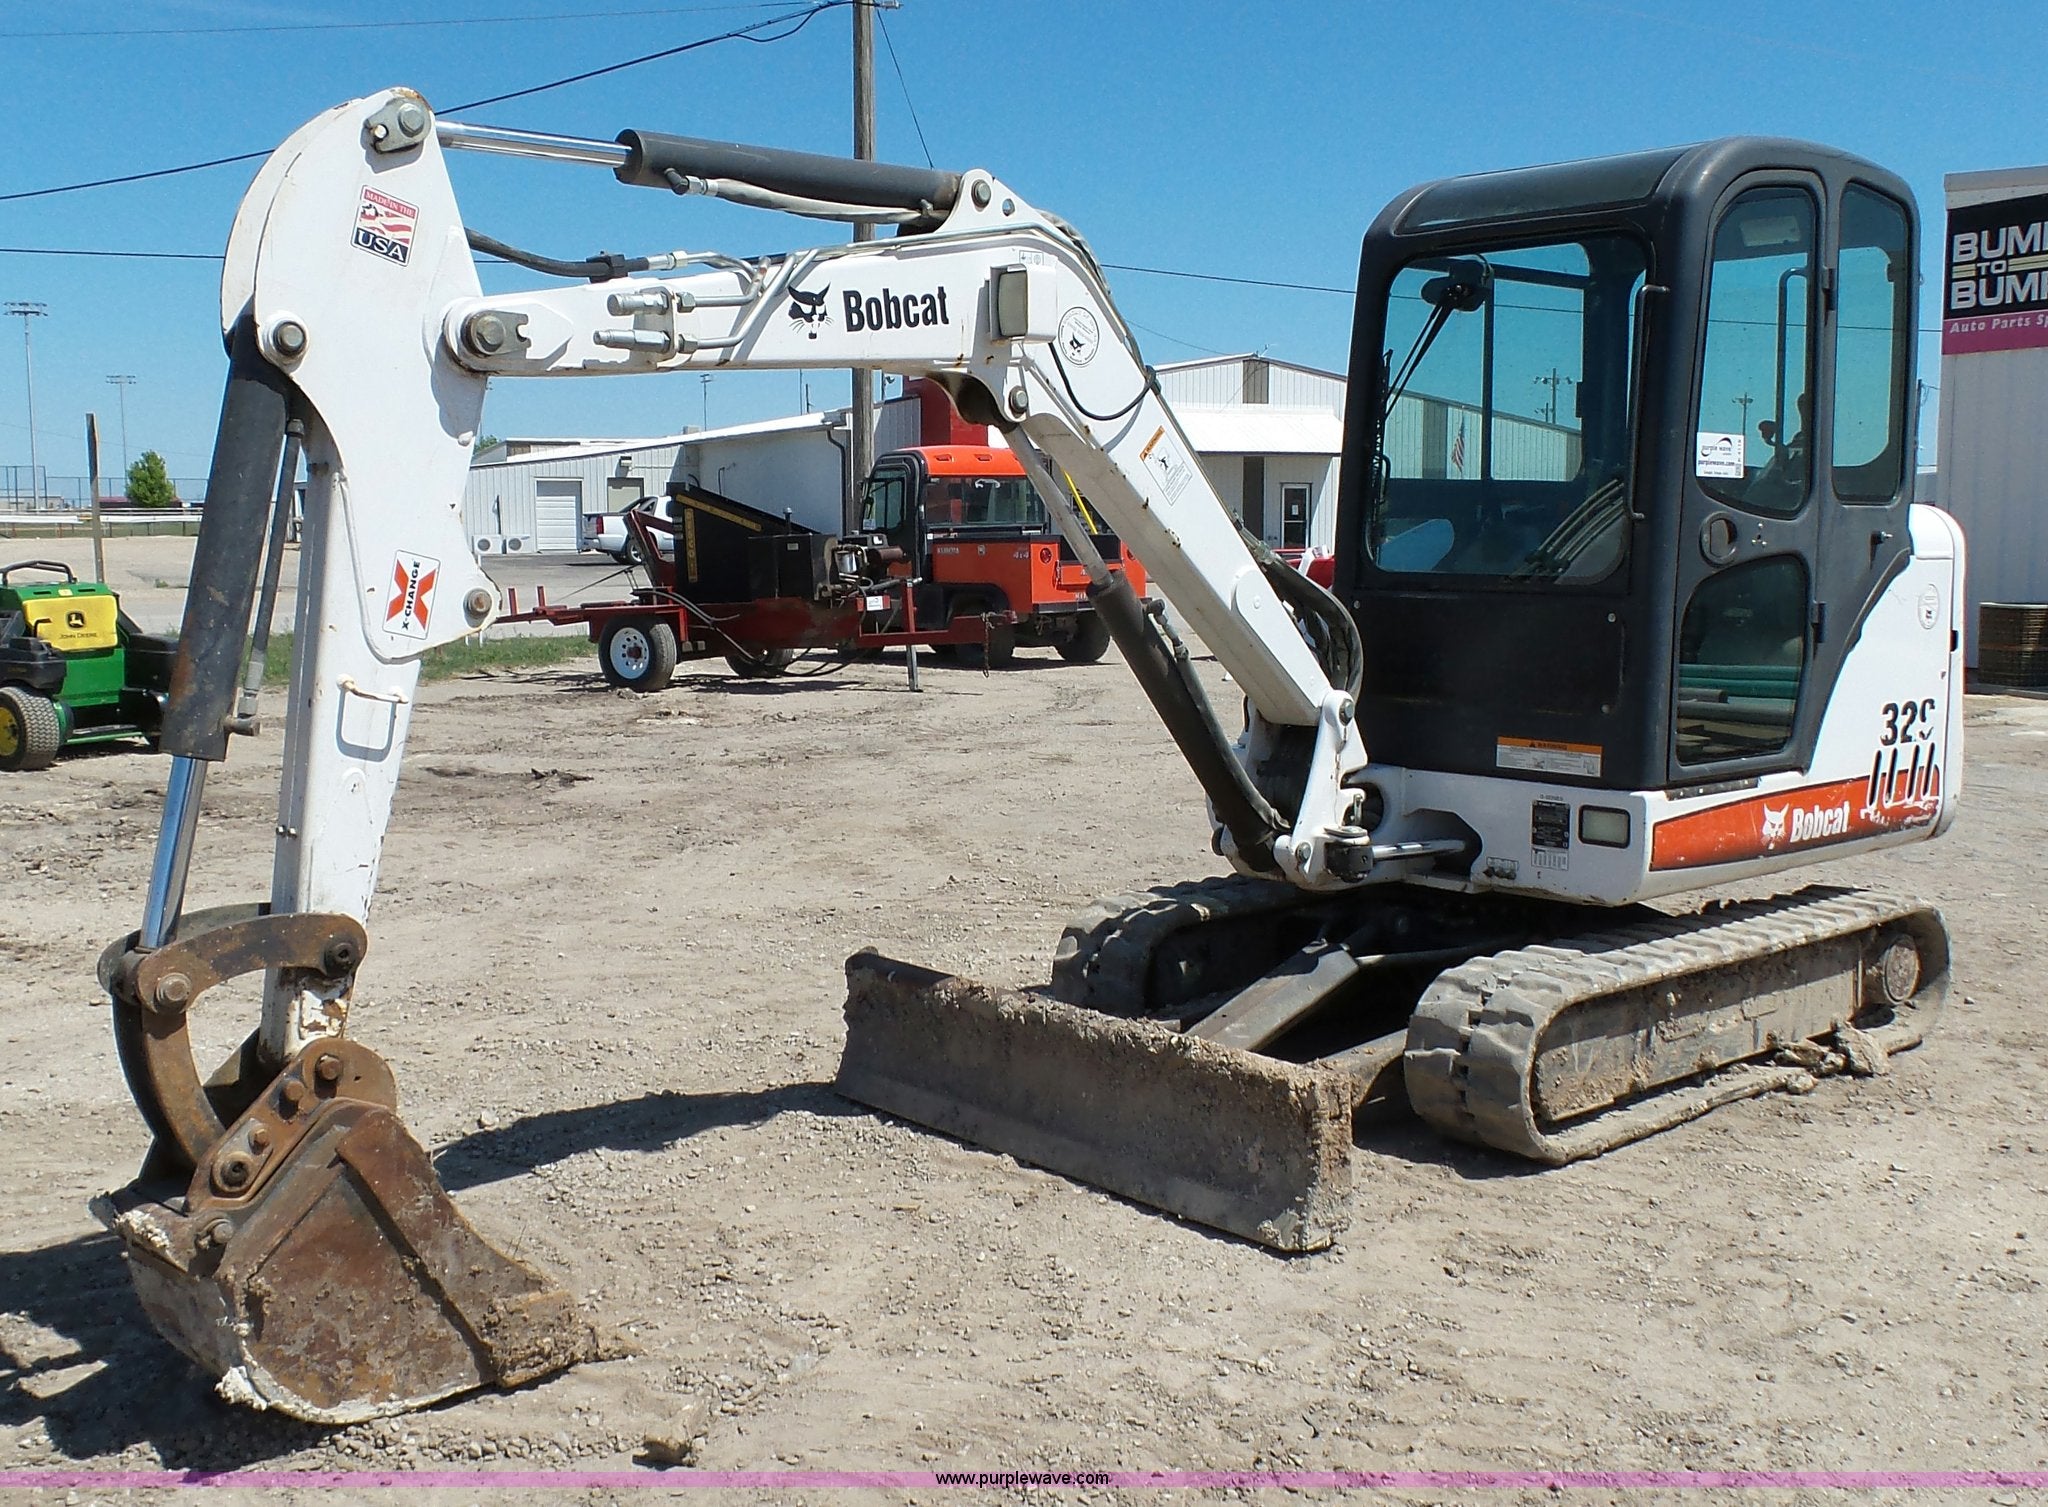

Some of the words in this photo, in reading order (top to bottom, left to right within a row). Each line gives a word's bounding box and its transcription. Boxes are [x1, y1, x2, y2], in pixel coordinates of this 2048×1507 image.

[365, 191, 388, 206] MADE
[389, 201, 398, 210] IN
[399, 205, 414, 217] THE
[358, 230, 404, 261] USA
[1953, 221, 2048, 263] BUM
[1976, 259, 2007, 275] TO
[842, 286, 949, 332] Bobcat
[1950, 320, 1986, 334] Auto
[1991, 316, 2031, 330] Parts
[402, 560, 421, 630] X-CHANGE
[1790, 800, 1850, 843] Bobcat
